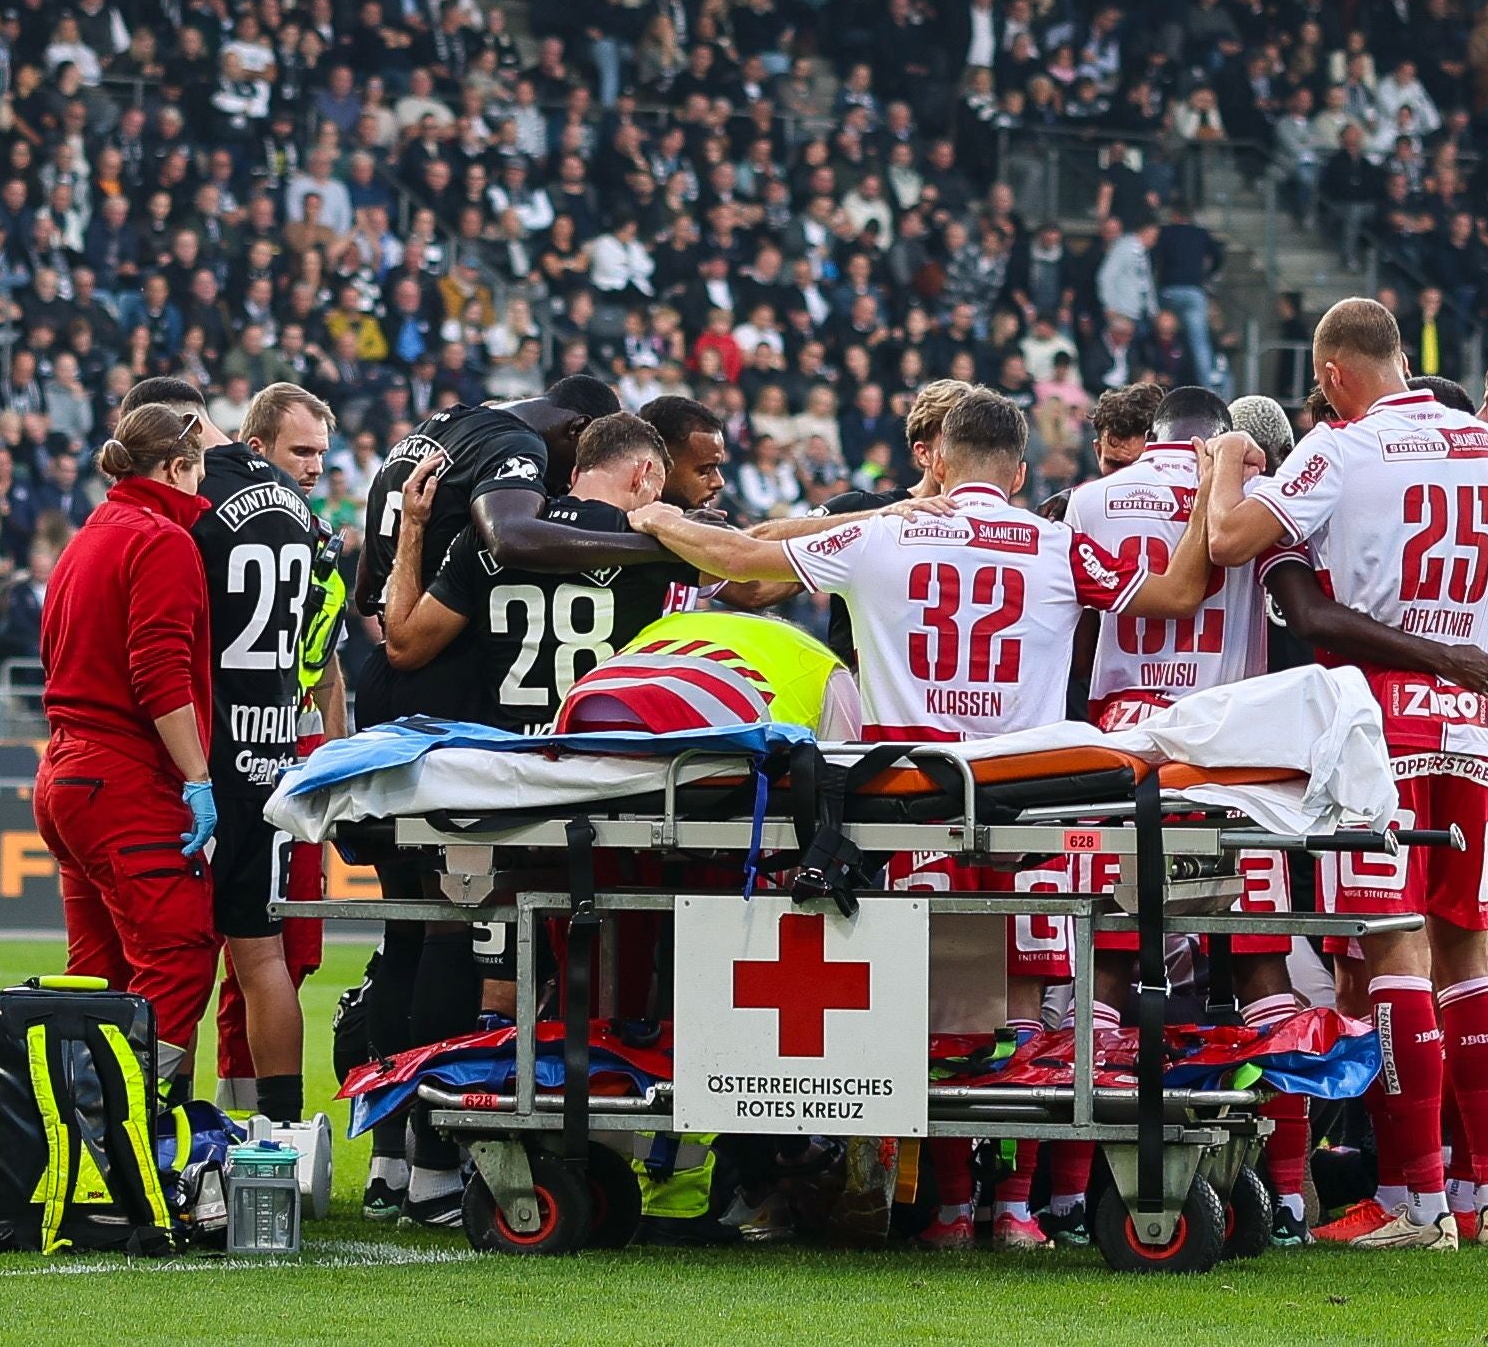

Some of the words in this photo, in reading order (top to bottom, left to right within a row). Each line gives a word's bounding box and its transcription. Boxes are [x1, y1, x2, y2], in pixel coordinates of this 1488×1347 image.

[978, 523, 1033, 542] SALANETTIS
[220, 543, 312, 670] 23
[908, 562, 1025, 683] 32
[489, 582, 615, 706] 28
[1140, 662, 1198, 687] OWUSU
[926, 688, 1002, 717] KLASSEN
[1402, 684, 1479, 719] ZIRO
[1069, 835, 1095, 849] 628
[1380, 1012, 1394, 1057] ENERGIE
[707, 1074, 893, 1096] ÖSTERREICHISCHES
[1385, 1060, 1400, 1092] GRAZ
[464, 1094, 494, 1108] 628
[736, 1100, 796, 1118] ROTES
[802, 1102, 864, 1119] KREUZ
